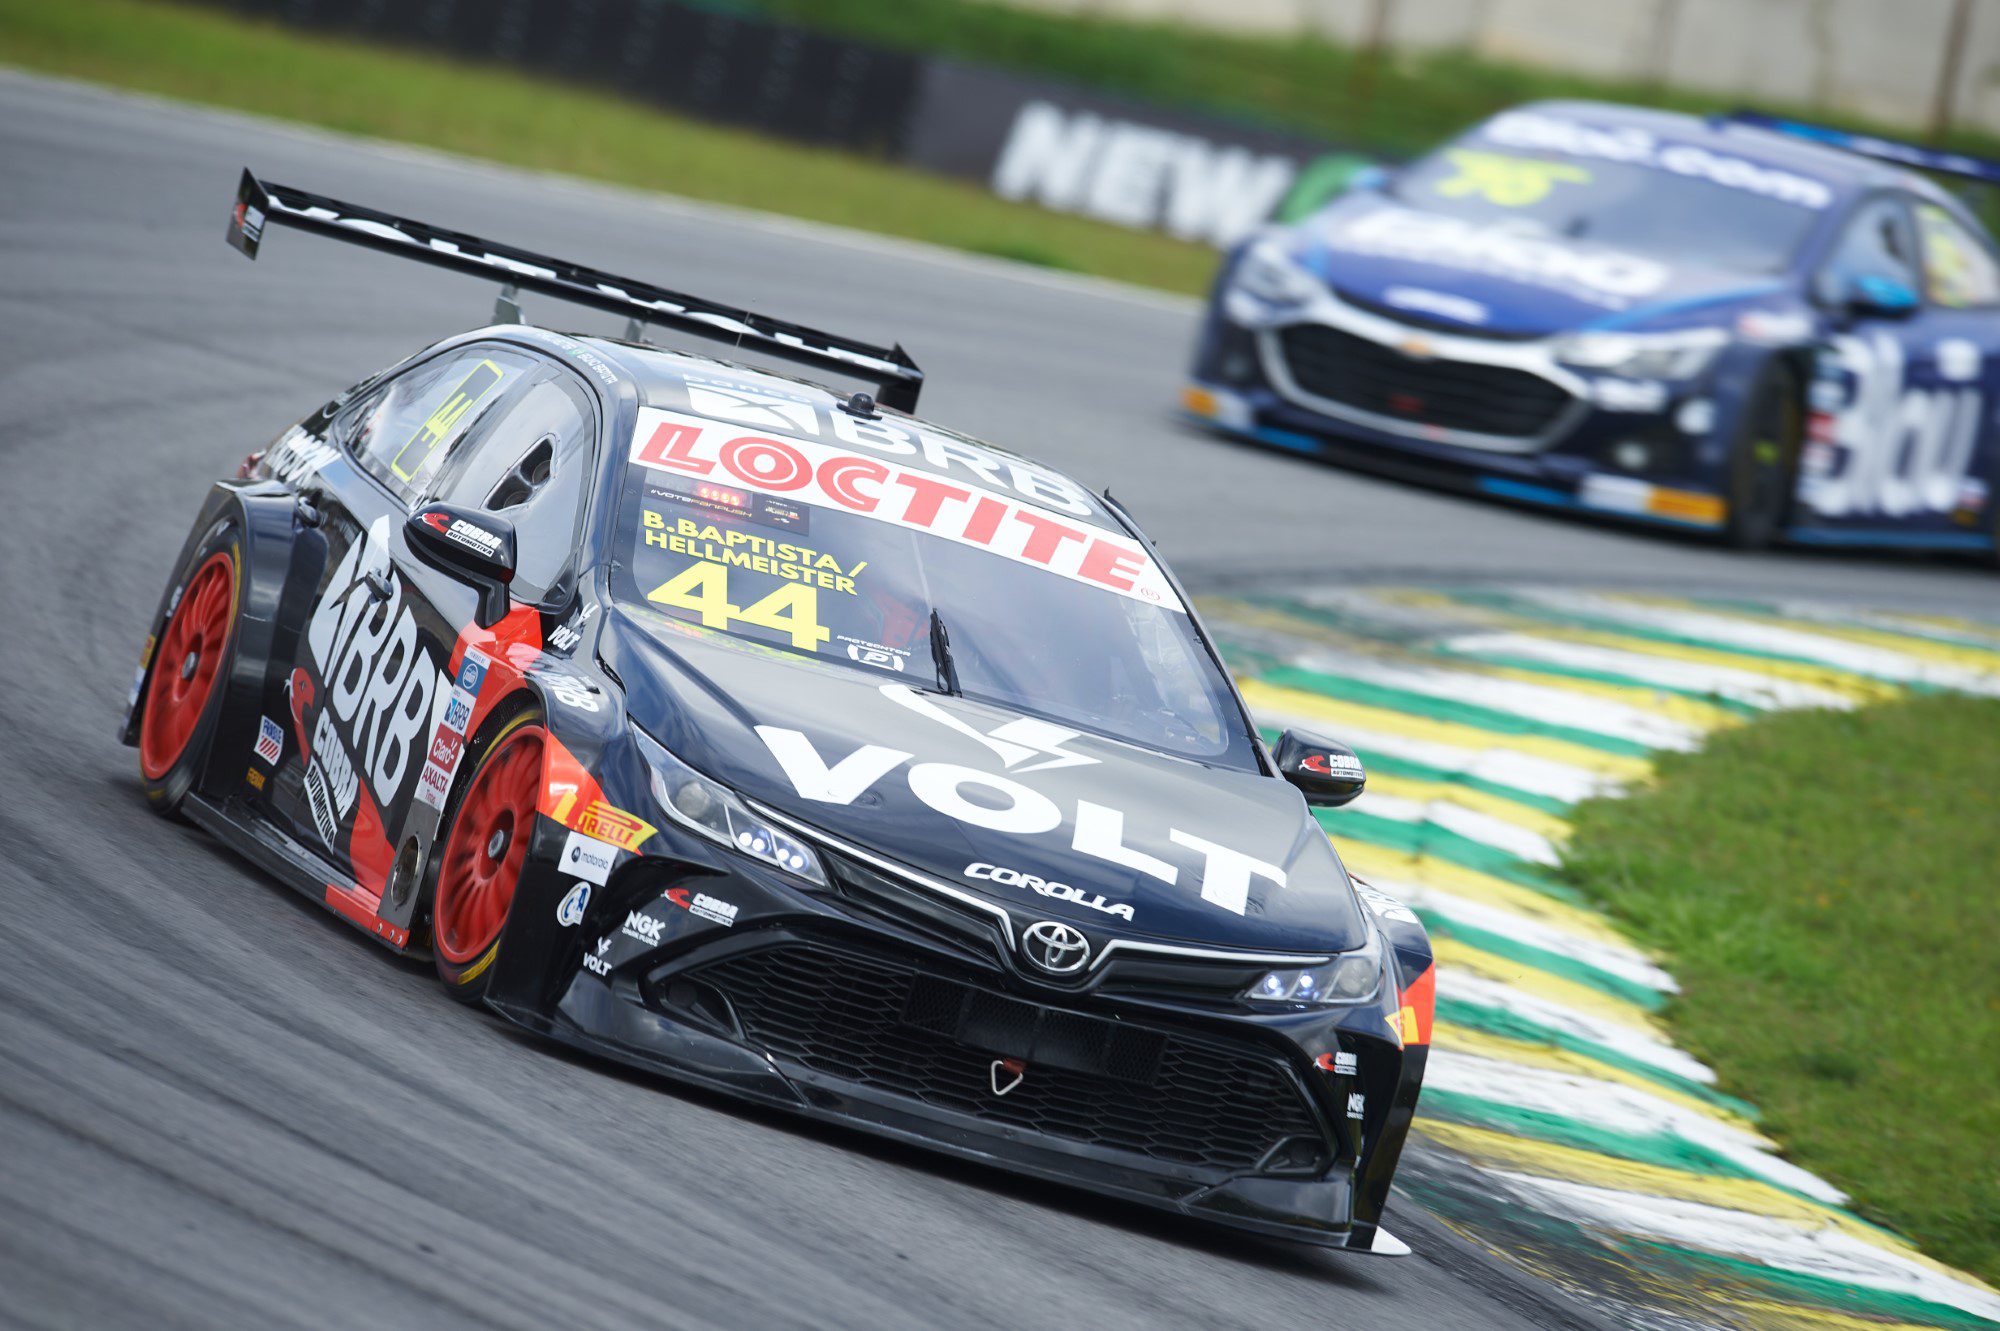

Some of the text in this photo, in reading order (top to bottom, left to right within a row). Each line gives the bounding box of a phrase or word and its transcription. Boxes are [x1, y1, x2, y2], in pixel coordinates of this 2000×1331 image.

[832, 409, 1093, 518] BRB
[638, 422, 1149, 593] LOCTITE
[447, 531, 494, 557] AUTOMOTIVA
[450, 518, 503, 550] COBRA
[645, 529, 858, 596] HELLMEISTER
[647, 560, 830, 652] 44
[547, 624, 582, 651] VOLT
[452, 698, 471, 731] BRB
[312, 706, 359, 822] COBRA
[433, 739, 451, 765] Claro
[1329, 754, 1363, 770] COBRA
[421, 764, 449, 795] AXALTA
[306, 763, 338, 850] AUTOMOTIVA
[753, 724, 1288, 917] VOLT
[692, 892, 739, 919] COBRA
[963, 862, 1136, 922] COROLLA
[624, 909, 666, 941] NGK
[582, 952, 613, 977] VOLT
